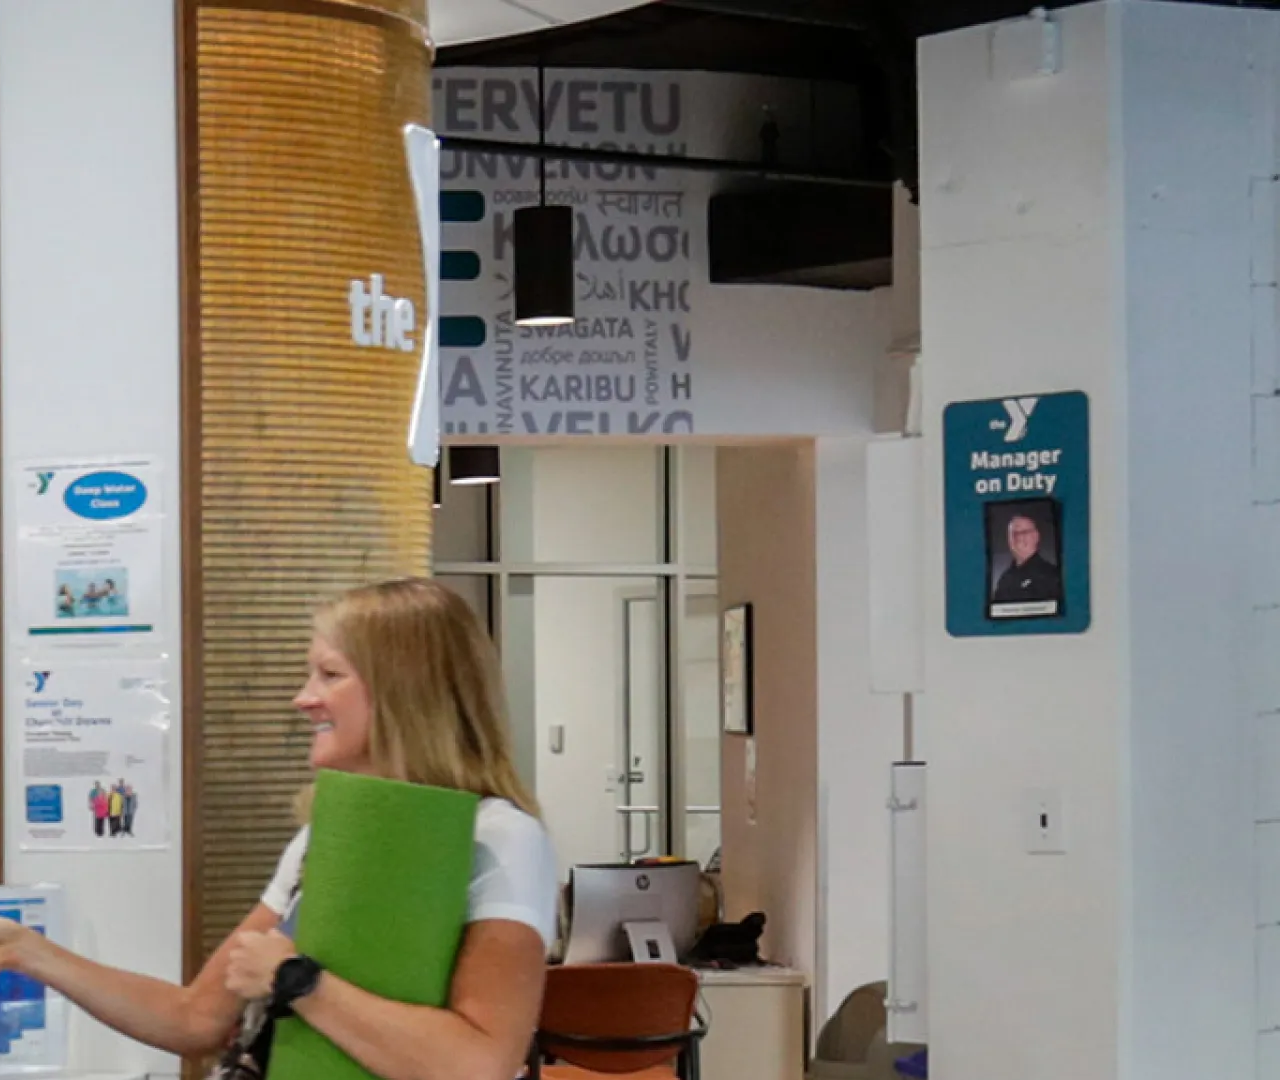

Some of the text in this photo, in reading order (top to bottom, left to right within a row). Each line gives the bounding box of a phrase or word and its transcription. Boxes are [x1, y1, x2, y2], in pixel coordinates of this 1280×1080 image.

[348, 272, 415, 352] the
[520, 374, 635, 402] KARIBU
[971, 449, 1062, 470] Manager
[976, 473, 1057, 494] on Duty
